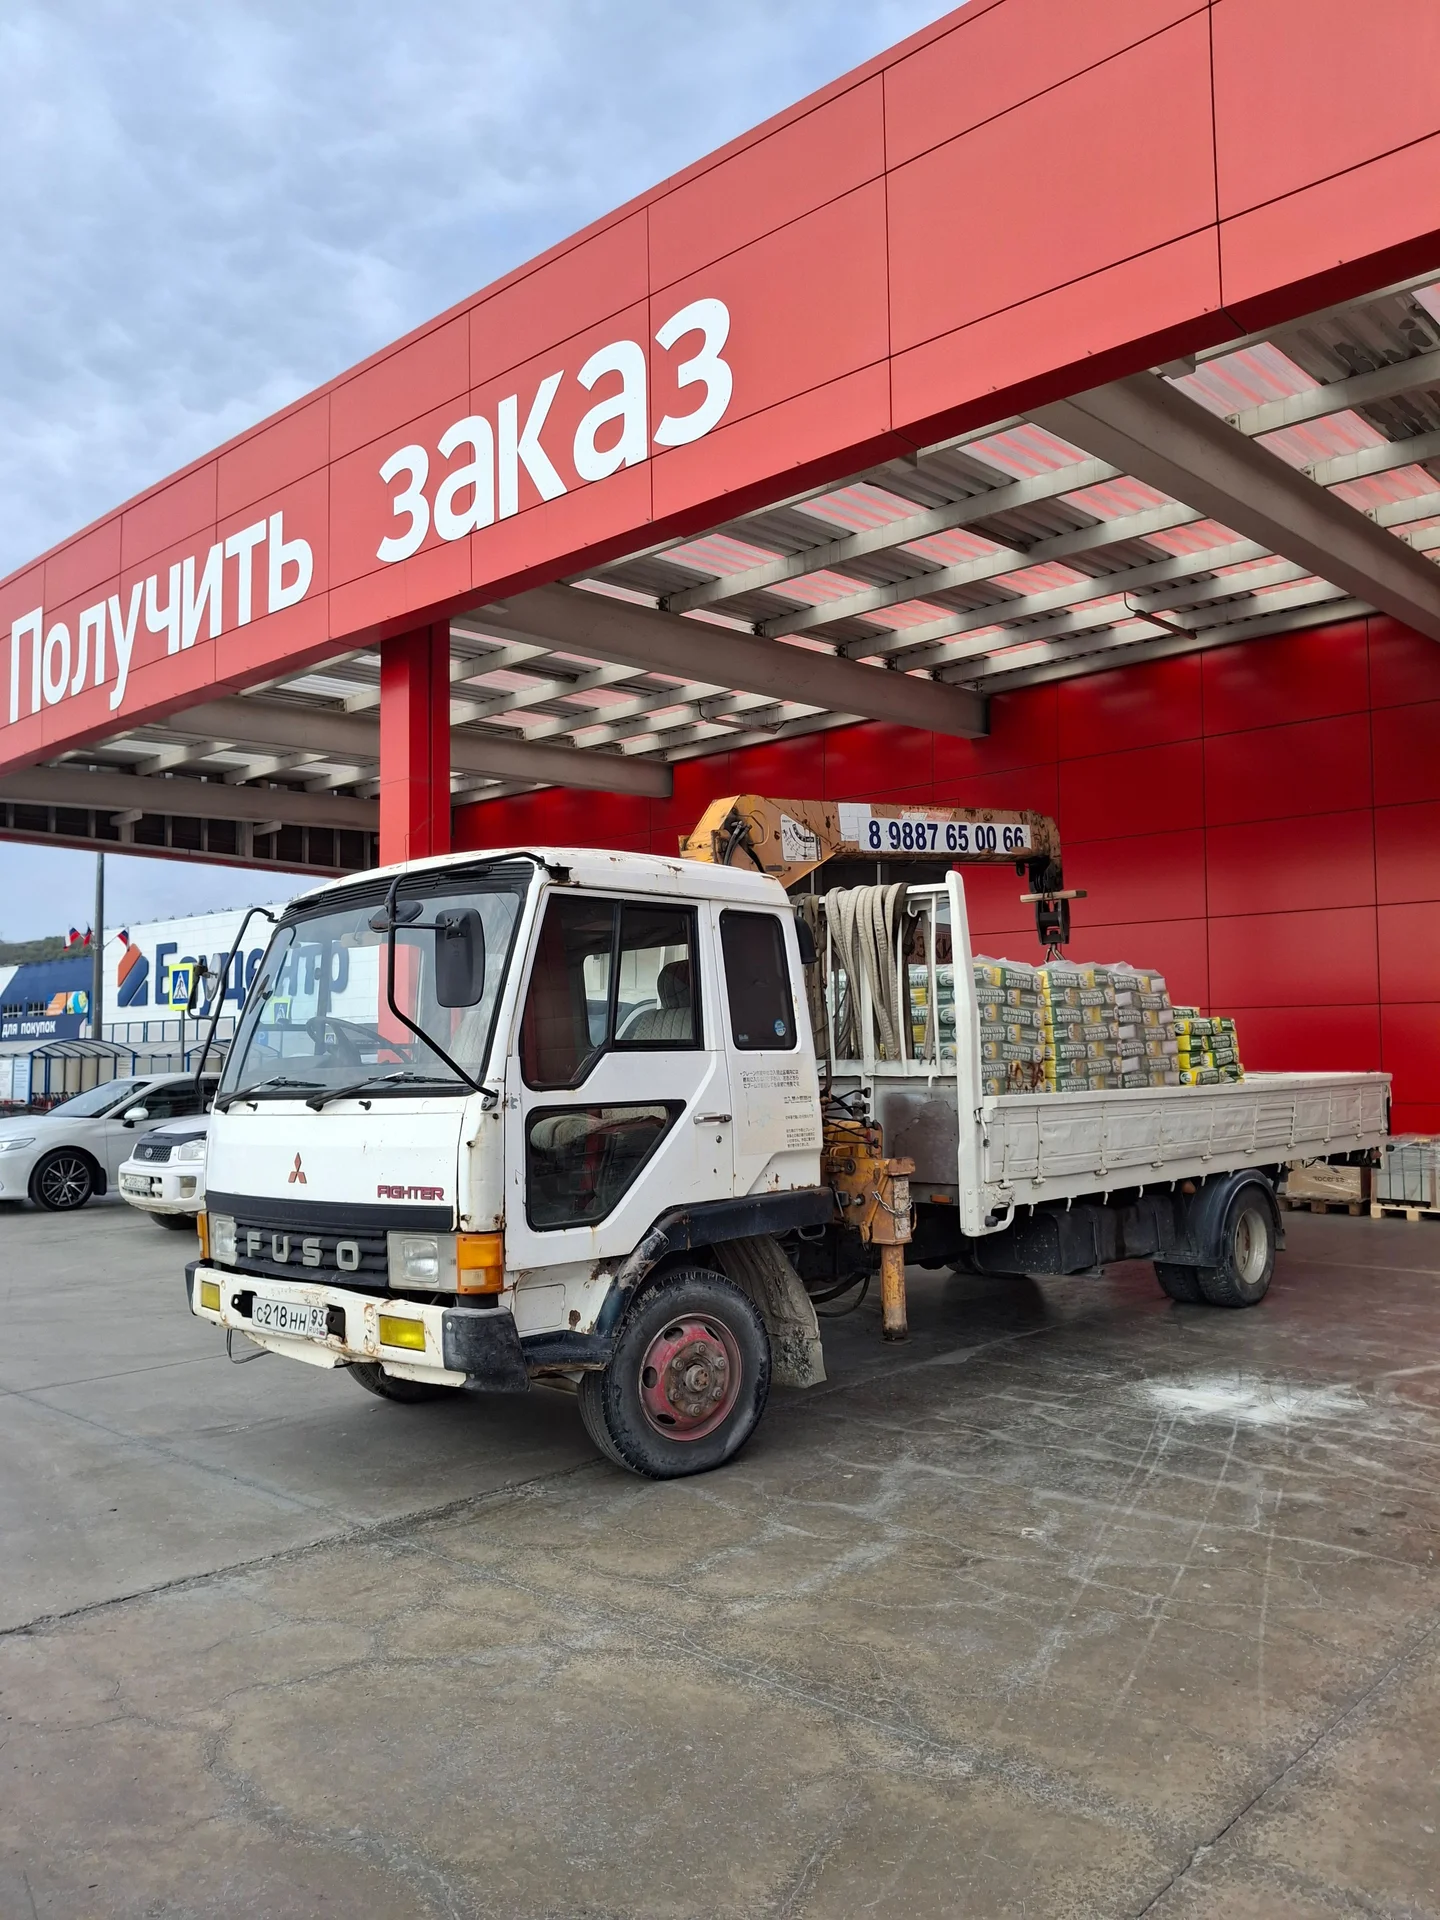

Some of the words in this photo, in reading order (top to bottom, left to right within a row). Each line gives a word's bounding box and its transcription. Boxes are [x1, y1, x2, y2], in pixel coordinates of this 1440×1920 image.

[10, 511, 313, 723] Получить
[376, 297, 733, 563] заказ
[869, 820, 881, 849] 8
[889, 821, 938, 850] 9887
[946, 825, 969, 851] 65
[975, 826, 996, 850] 00
[1003, 827, 1023, 851] 66
[155, 942, 349, 1015] Буцентр
[21, 1021, 56, 1037] покупок
[377, 1185, 444, 1201] FIGHTER
[246, 1231, 362, 1271] FUSO
[311, 1309, 324, 1327] 93
